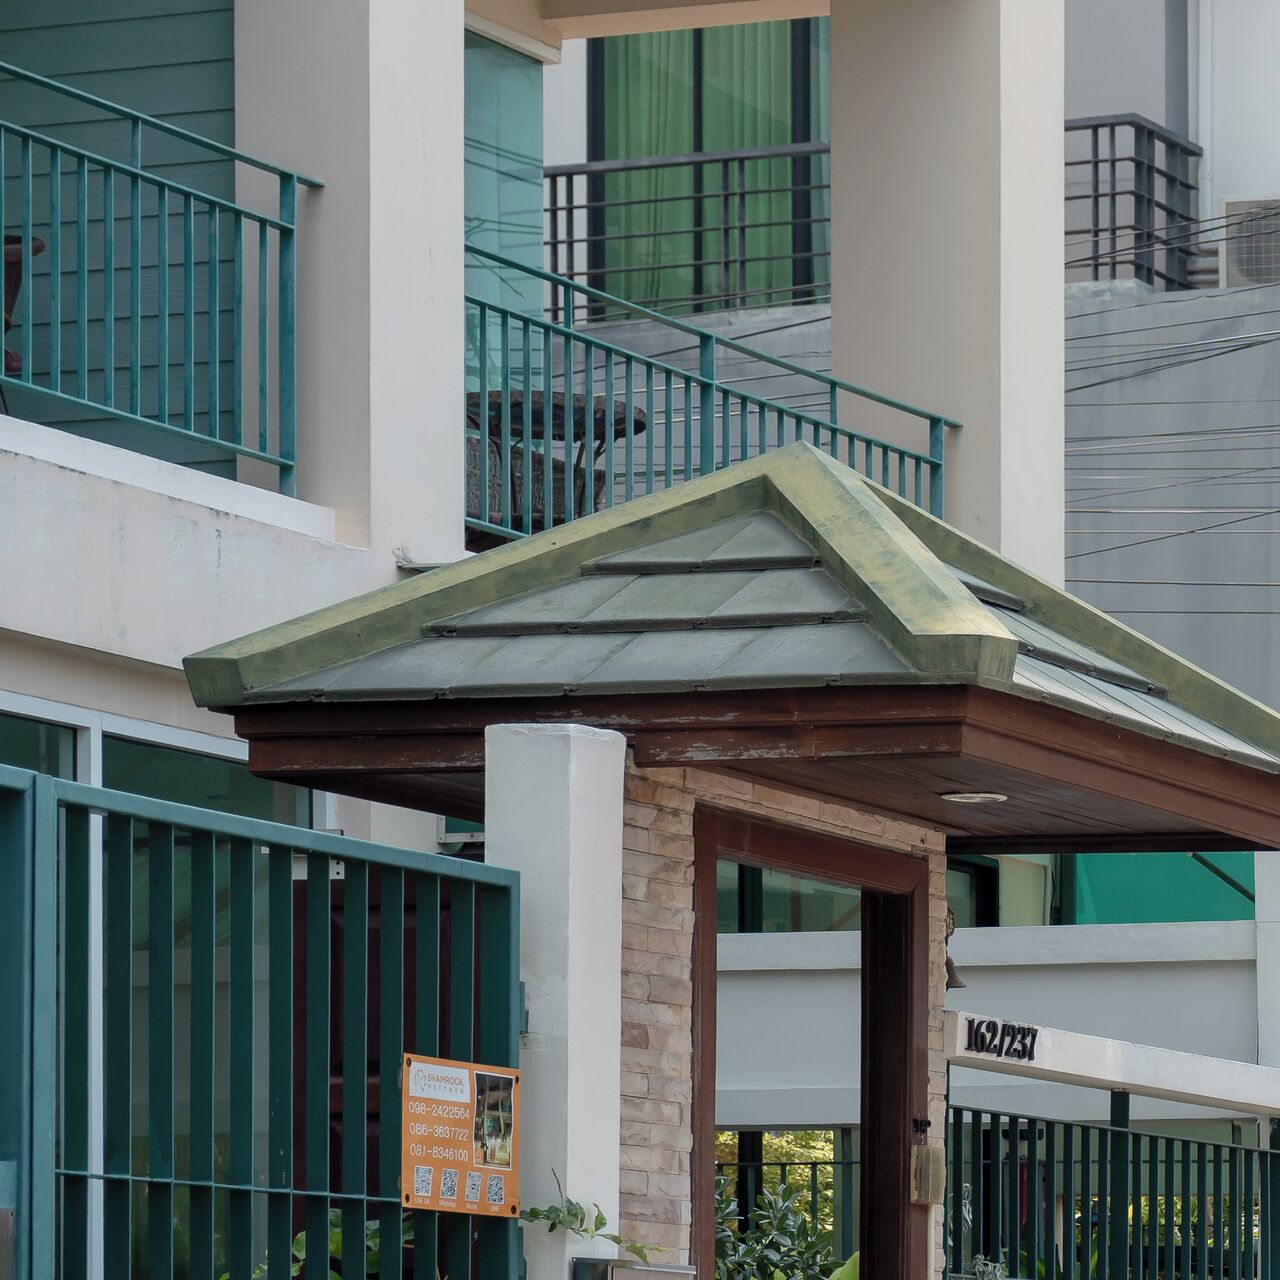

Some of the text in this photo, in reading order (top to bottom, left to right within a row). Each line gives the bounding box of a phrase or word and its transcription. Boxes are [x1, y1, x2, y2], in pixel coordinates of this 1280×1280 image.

[964, 1017, 1039, 1061] 162/237
[427, 1073, 465, 1087] SHAMROCK
[427, 1083, 465, 1095] PATTAYA
[408, 1101, 470, 1120] 098-2422564
[409, 1122, 469, 1141] 086-3637722
[409, 1143, 469, 1162] 081-8346100
